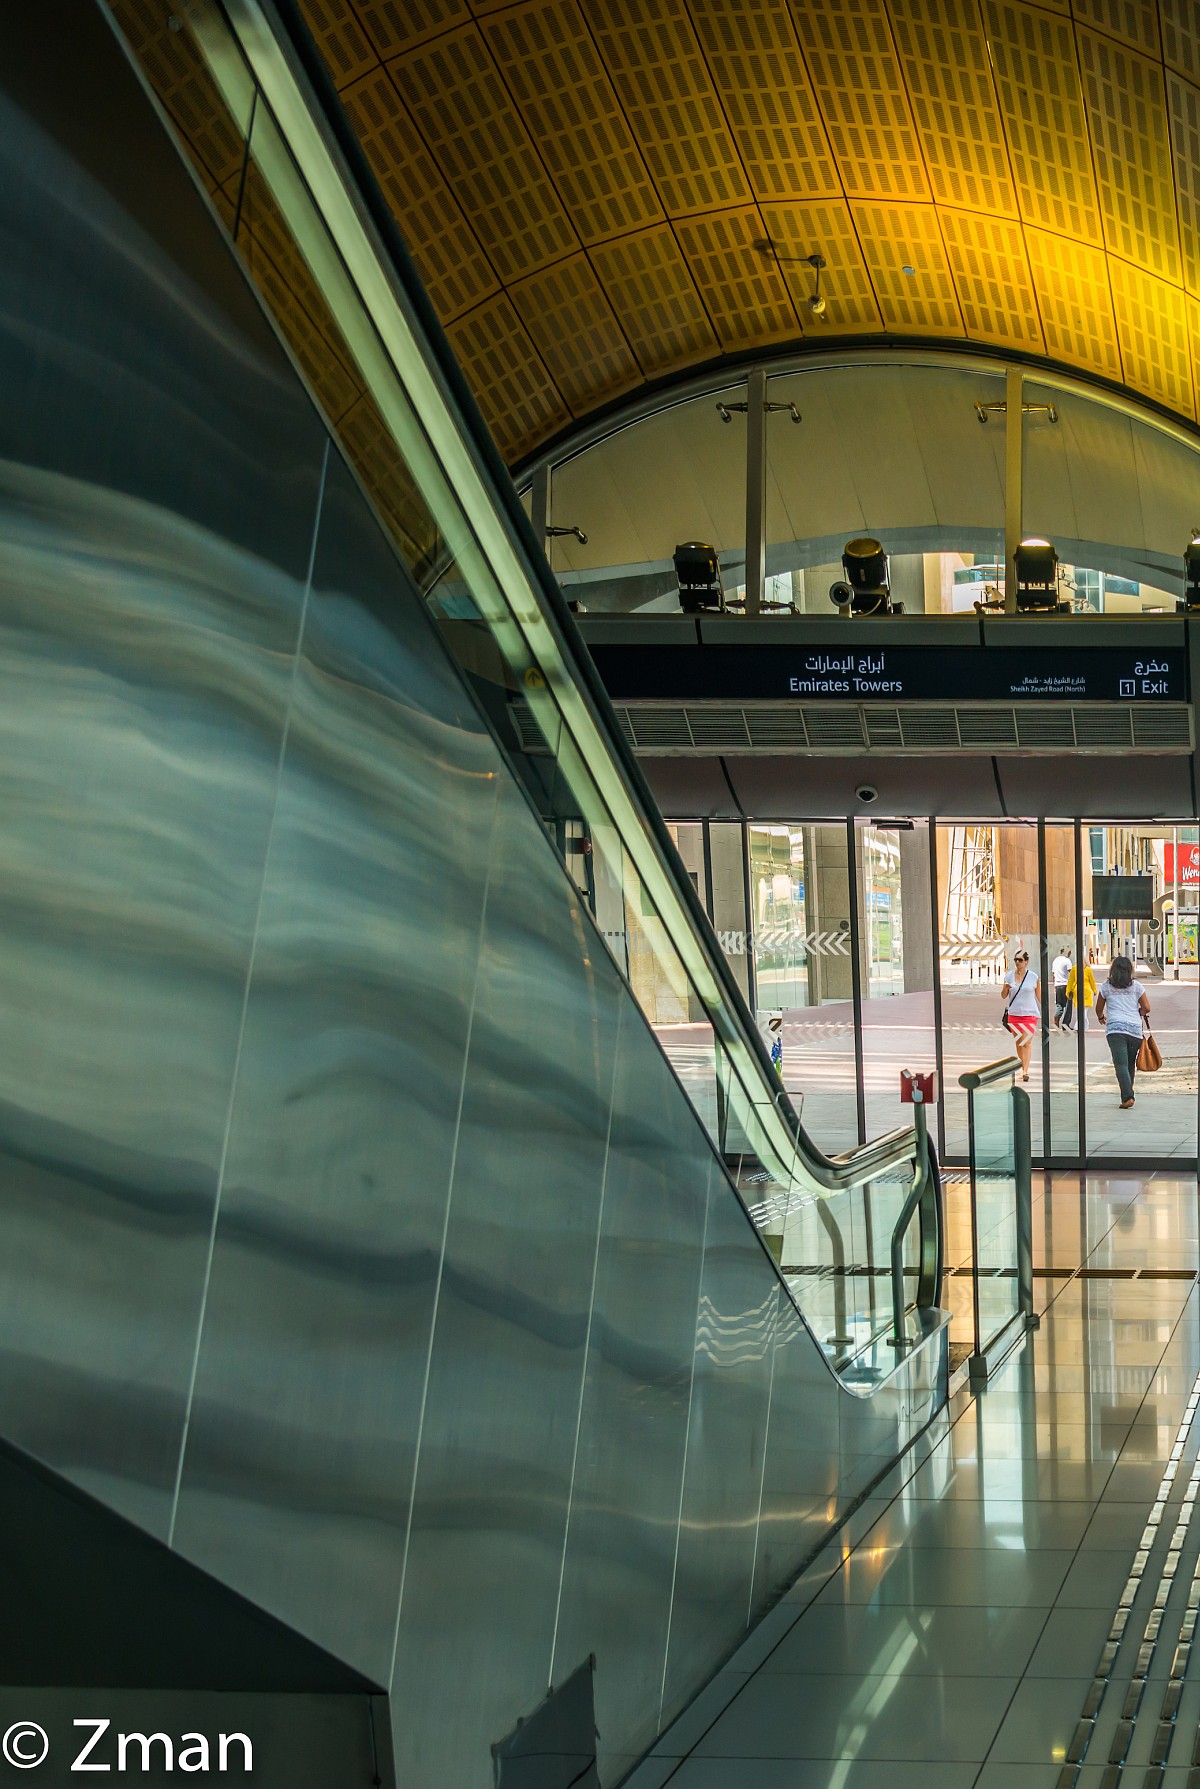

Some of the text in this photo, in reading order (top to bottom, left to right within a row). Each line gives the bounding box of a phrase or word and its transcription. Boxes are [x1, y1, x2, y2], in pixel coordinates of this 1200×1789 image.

[805, 652, 885, 674] أبراج الإمارات
[1134, 659, 1169, 676] مخرج
[789, 677, 903, 692] Emirates Towers
[1010, 685, 1086, 693] Sheikh Zayed Road (North)
[1142, 679, 1169, 694] Exit
